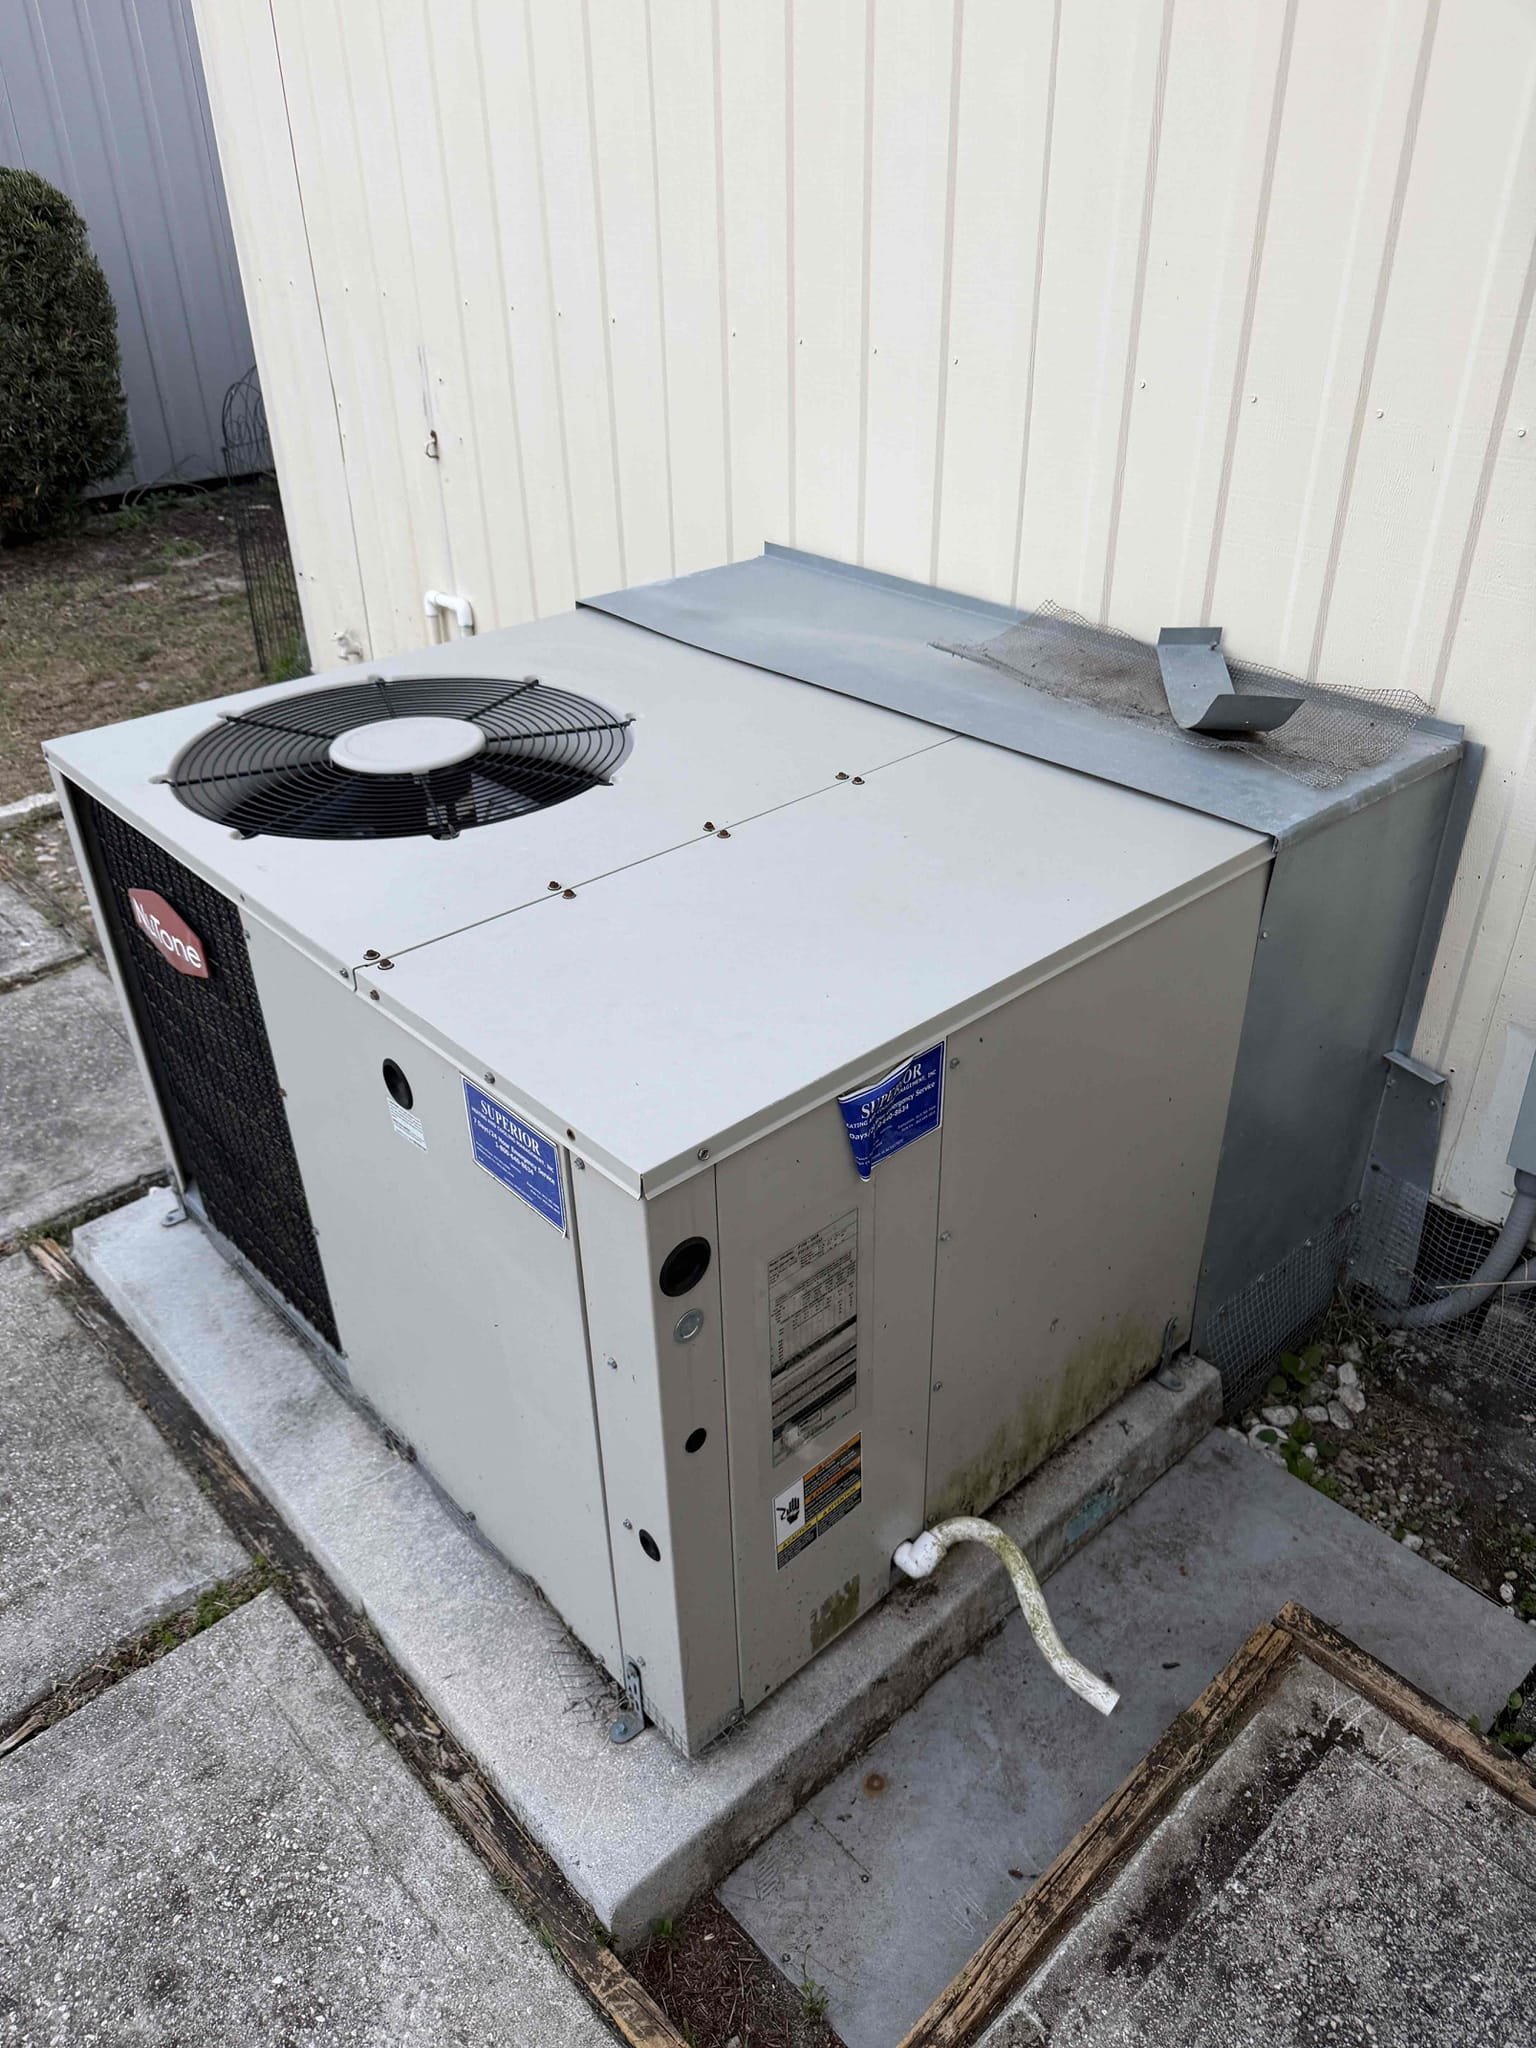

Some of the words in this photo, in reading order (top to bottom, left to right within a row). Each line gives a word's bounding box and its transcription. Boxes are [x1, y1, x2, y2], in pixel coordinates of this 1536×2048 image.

[131, 897, 202, 969] NuTone
[915, 1081, 936, 1097] Service
[480, 1099, 541, 1156] SUPERIOR
[511, 1145, 537, 1172] Emergency
[538, 1166, 556, 1186] Service
